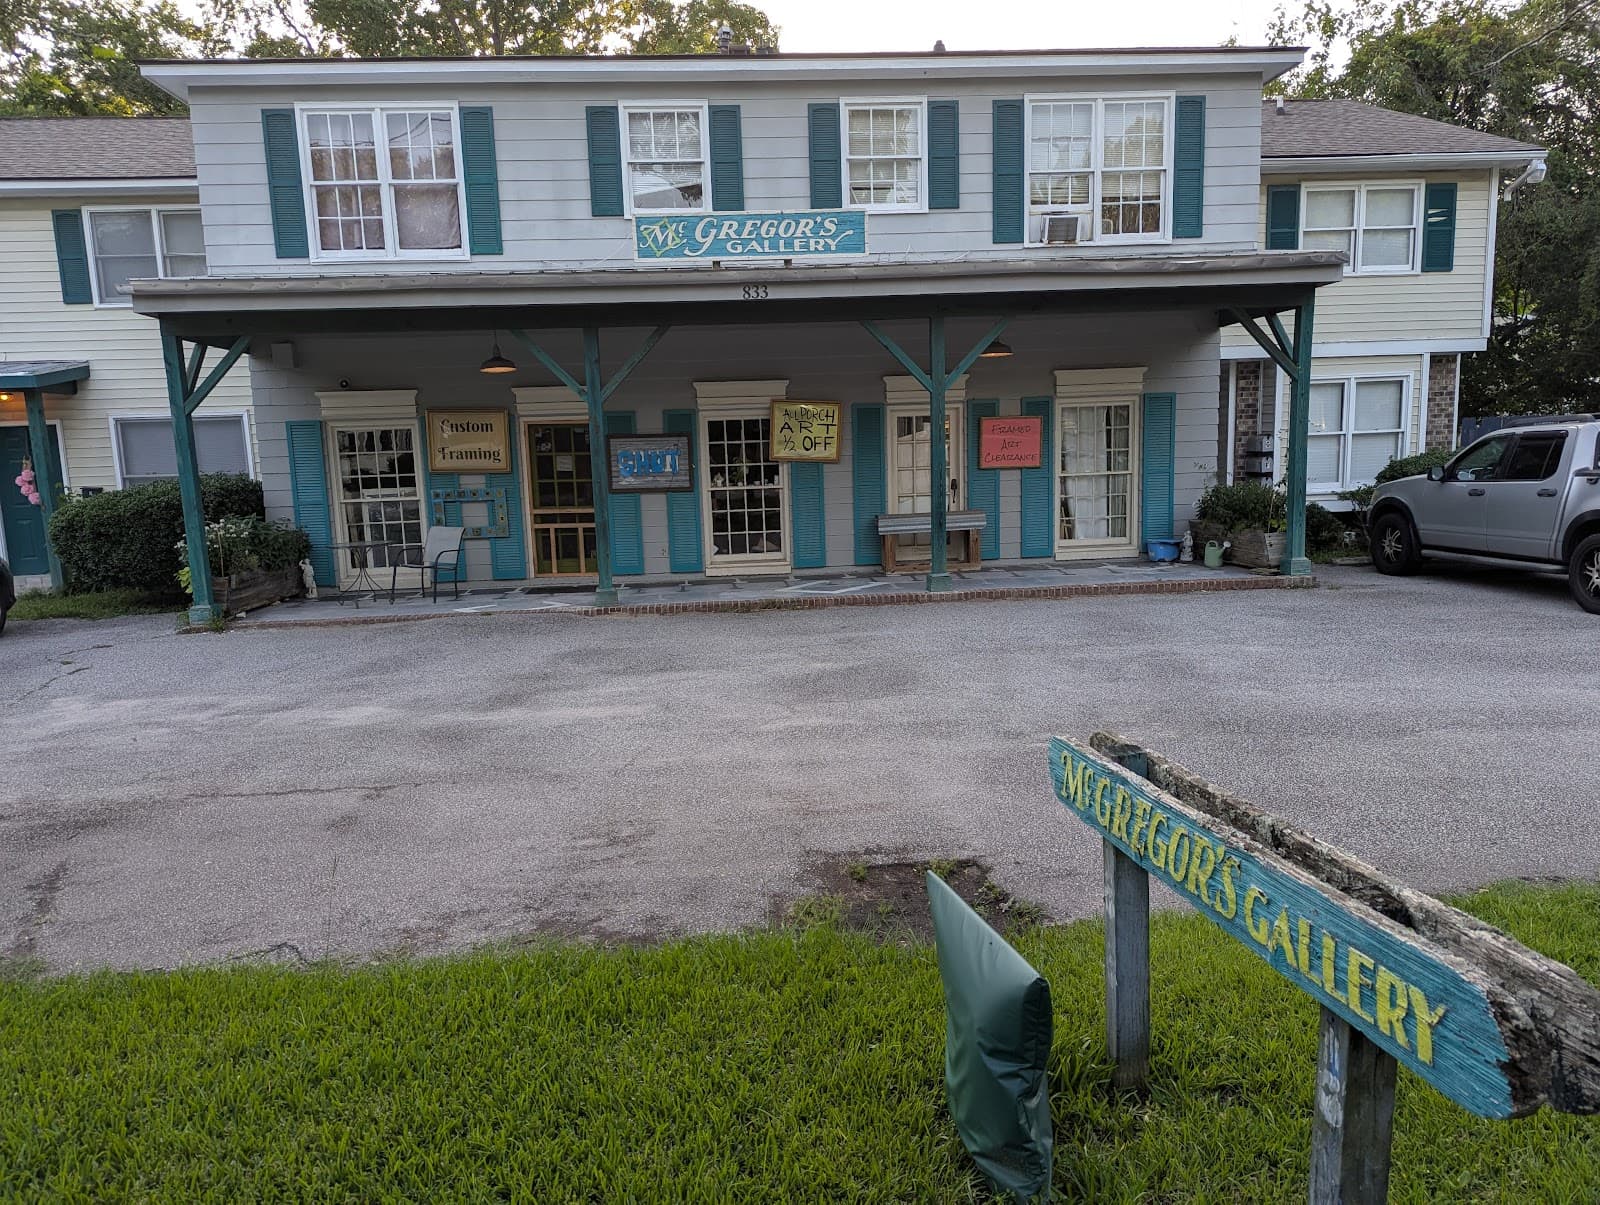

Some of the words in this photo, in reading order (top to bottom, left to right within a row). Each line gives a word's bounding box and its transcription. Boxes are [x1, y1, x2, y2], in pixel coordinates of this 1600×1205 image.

[726, 229, 854, 254] GALLERY
[742, 285, 769, 300] 833
[782, 408, 799, 421] ALL
[800, 406, 835, 423] PORCH
[440, 418, 493, 433] Custom
[779, 420, 837, 434] ART
[802, 435, 835, 451] OFF
[438, 447, 502, 464] Framing
[617, 448, 681, 478] SHUT
[1243, 885, 1448, 1067] GALLERY
